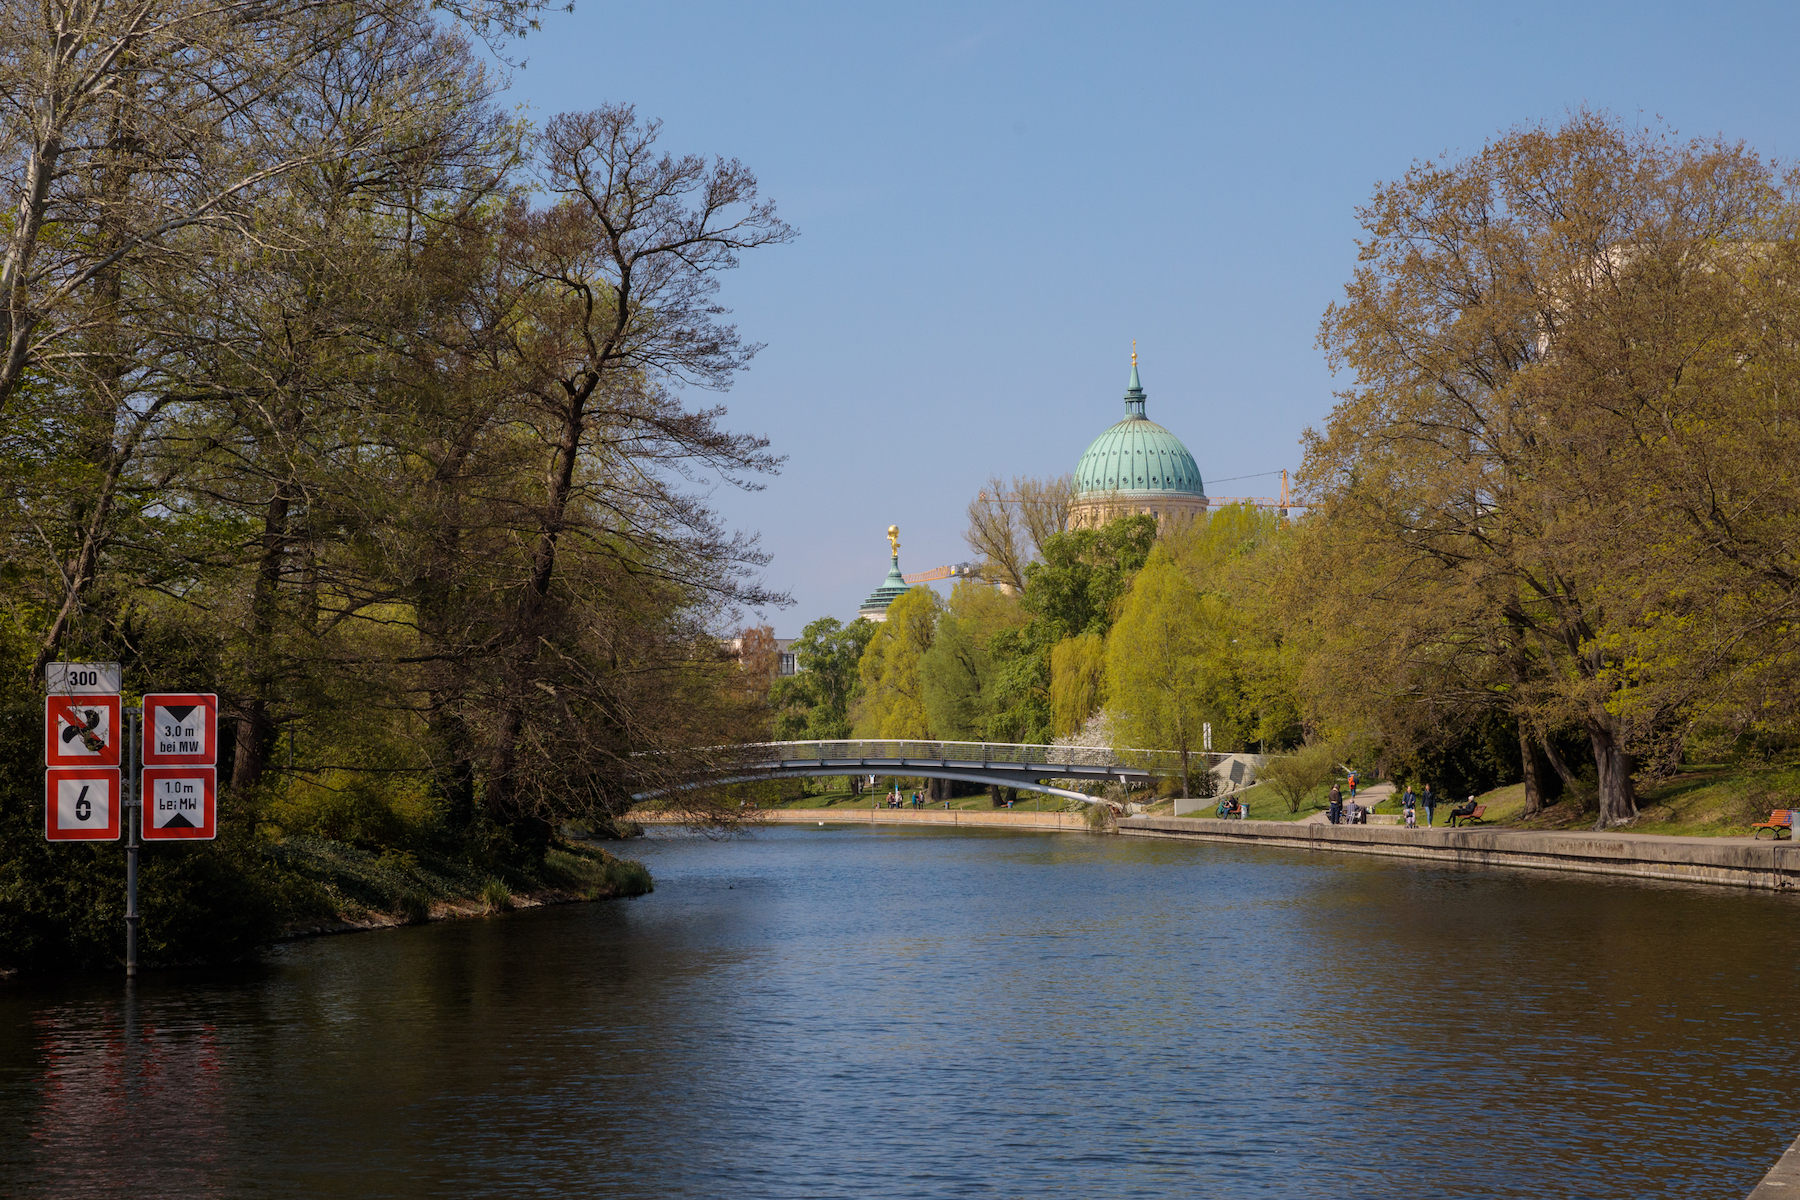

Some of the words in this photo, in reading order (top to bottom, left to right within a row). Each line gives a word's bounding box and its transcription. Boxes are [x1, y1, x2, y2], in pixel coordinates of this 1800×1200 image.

[70, 671, 97, 686] 300
[185, 728, 194, 737] m
[160, 741, 176, 752] bei
[179, 741, 199, 752] MW
[183, 784, 193, 793] m
[75, 785, 91, 821] 6
[159, 798, 176, 810] bei
[180, 798, 197, 810] MW
